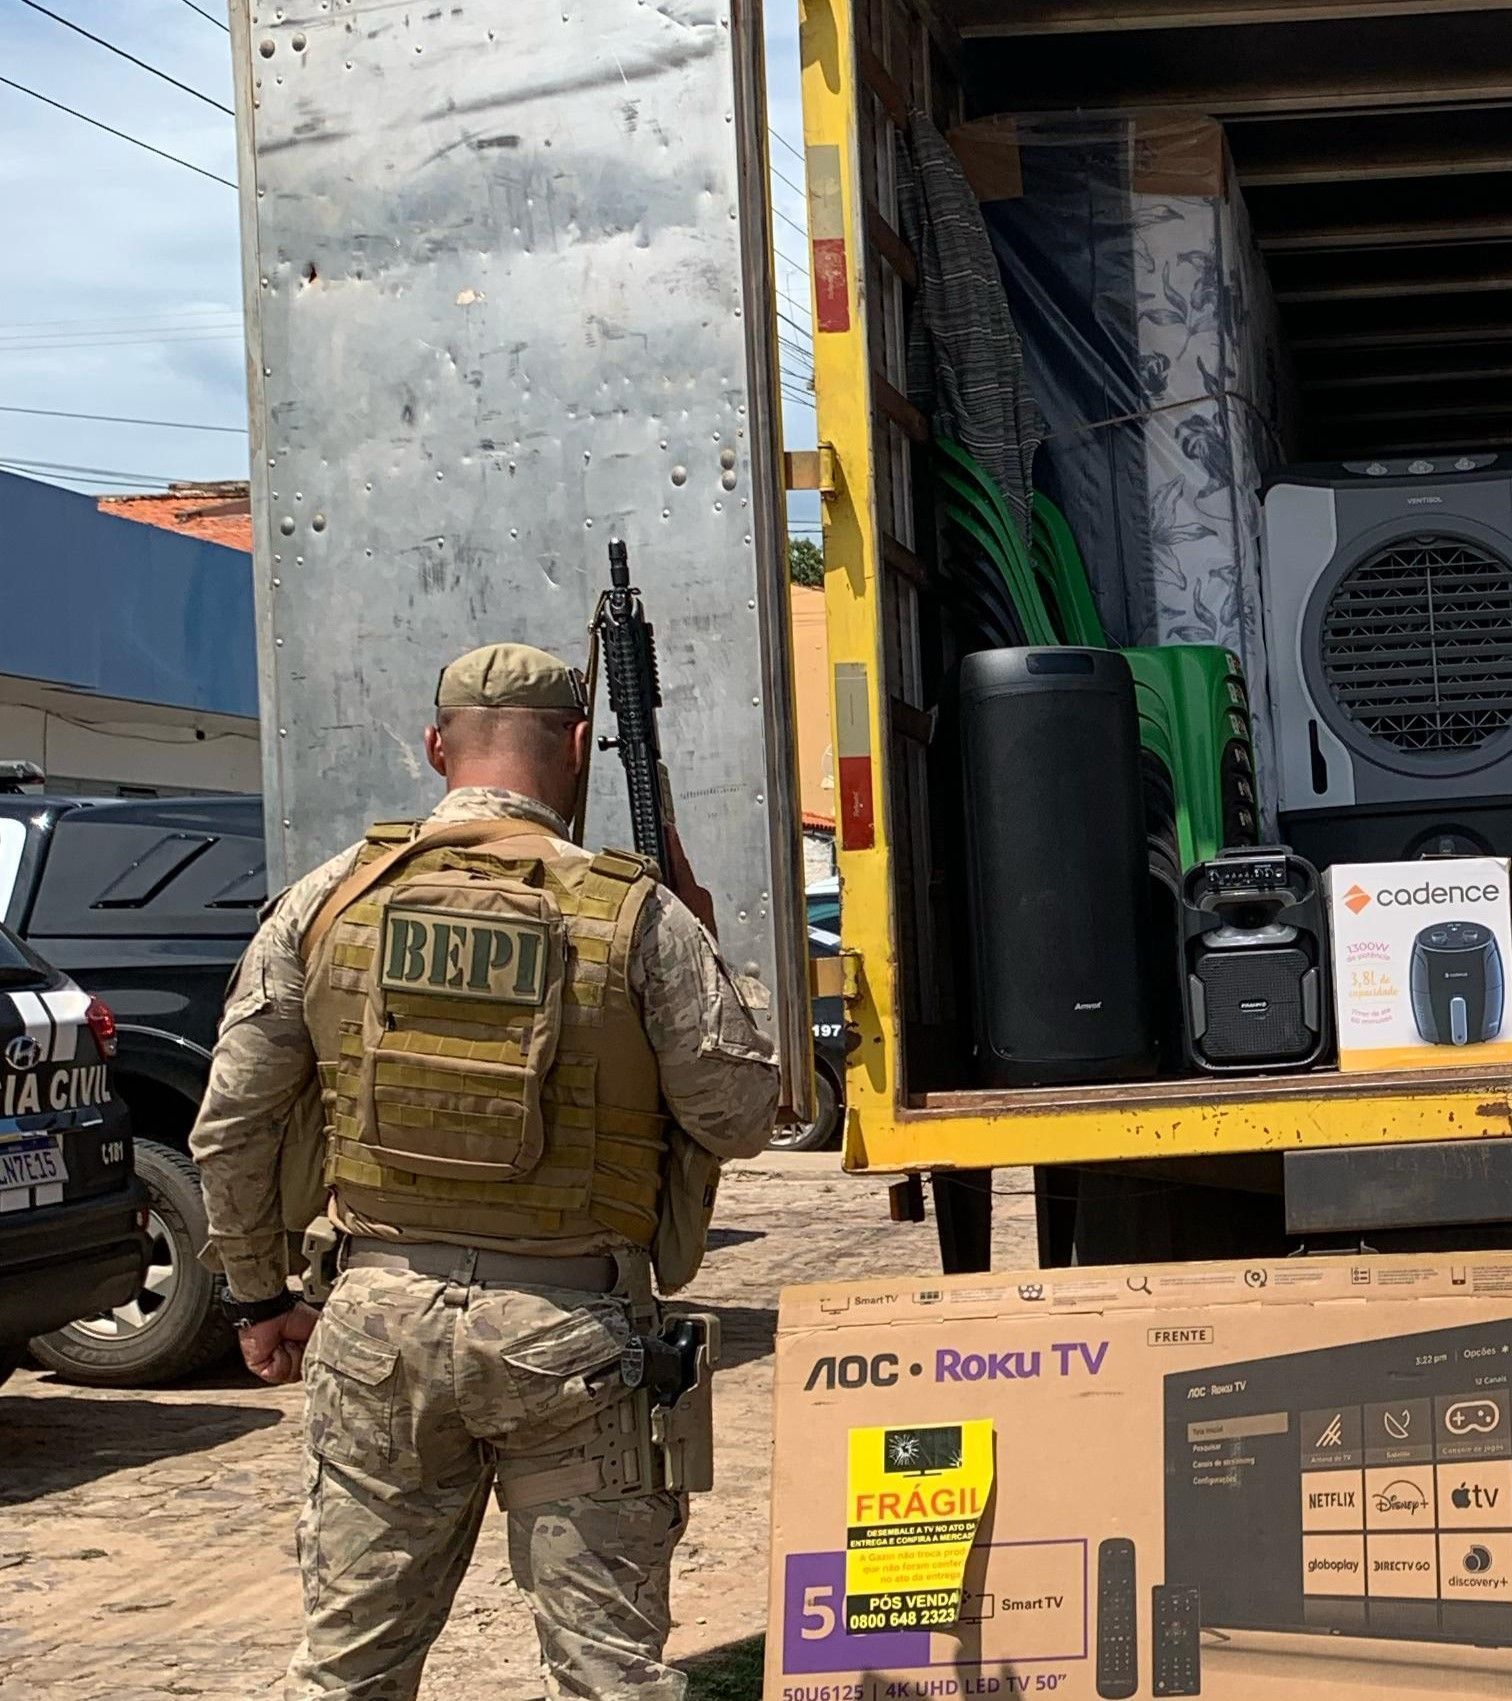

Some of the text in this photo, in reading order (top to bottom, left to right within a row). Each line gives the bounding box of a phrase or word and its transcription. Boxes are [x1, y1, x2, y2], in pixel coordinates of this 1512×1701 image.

[1376, 881, 1500, 908] cadence
[1346, 941, 1390, 954] 1300W
[386, 917, 542, 996] BEPI
[811, 1023, 842, 1038] 197
[0, 1063, 112, 1117] IA CIVIL
[883, 1294, 899, 1305] TV
[1154, 1328, 1208, 1344] FRENTE
[1463, 1347, 1497, 1361] Opções
[803, 1341, 1110, 1392] AOC Roku TV
[1233, 1380, 1247, 1392] TV
[856, 1483, 982, 1522] FRÁGIL
[1308, 1491, 1356, 1510] NETFLIX
[1472, 1483, 1499, 1509] tv
[866, 1525, 915, 1538] DESEMBALE
[916, 1525, 923, 1534] A
[923, 1524, 934, 1534] TV
[935, 1524, 948, 1533] NO
[948, 1523, 964, 1533] ATO
[850, 1537, 888, 1548] ENTREGA
[889, 1537, 895, 1546] E
[895, 1535, 932, 1545] CONFIRA
[932, 1535, 939, 1543] A
[897, 1549, 915, 1560] não
[917, 1548, 941, 1559] troca
[1308, 1557, 1360, 1573] globoplay
[1373, 1560, 1431, 1572] DIRECTV GO
[880, 1575, 892, 1584] no
[894, 1573, 911, 1583] ato
[912, 1572, 924, 1582] da
[1448, 1575, 1509, 1590] discovery+
[869, 1592, 958, 1612] PÓS VENDA
[1001, 1595, 1064, 1612] Smart TV
[850, 1608, 956, 1630] 0800 648 2323
[782, 1684, 865, 1701] 50U6125
[884, 1682, 910, 1698] 4K
[915, 1679, 959, 1697] UHD
[965, 1677, 1000, 1695] LED
[1005, 1675, 1031, 1693] TV
